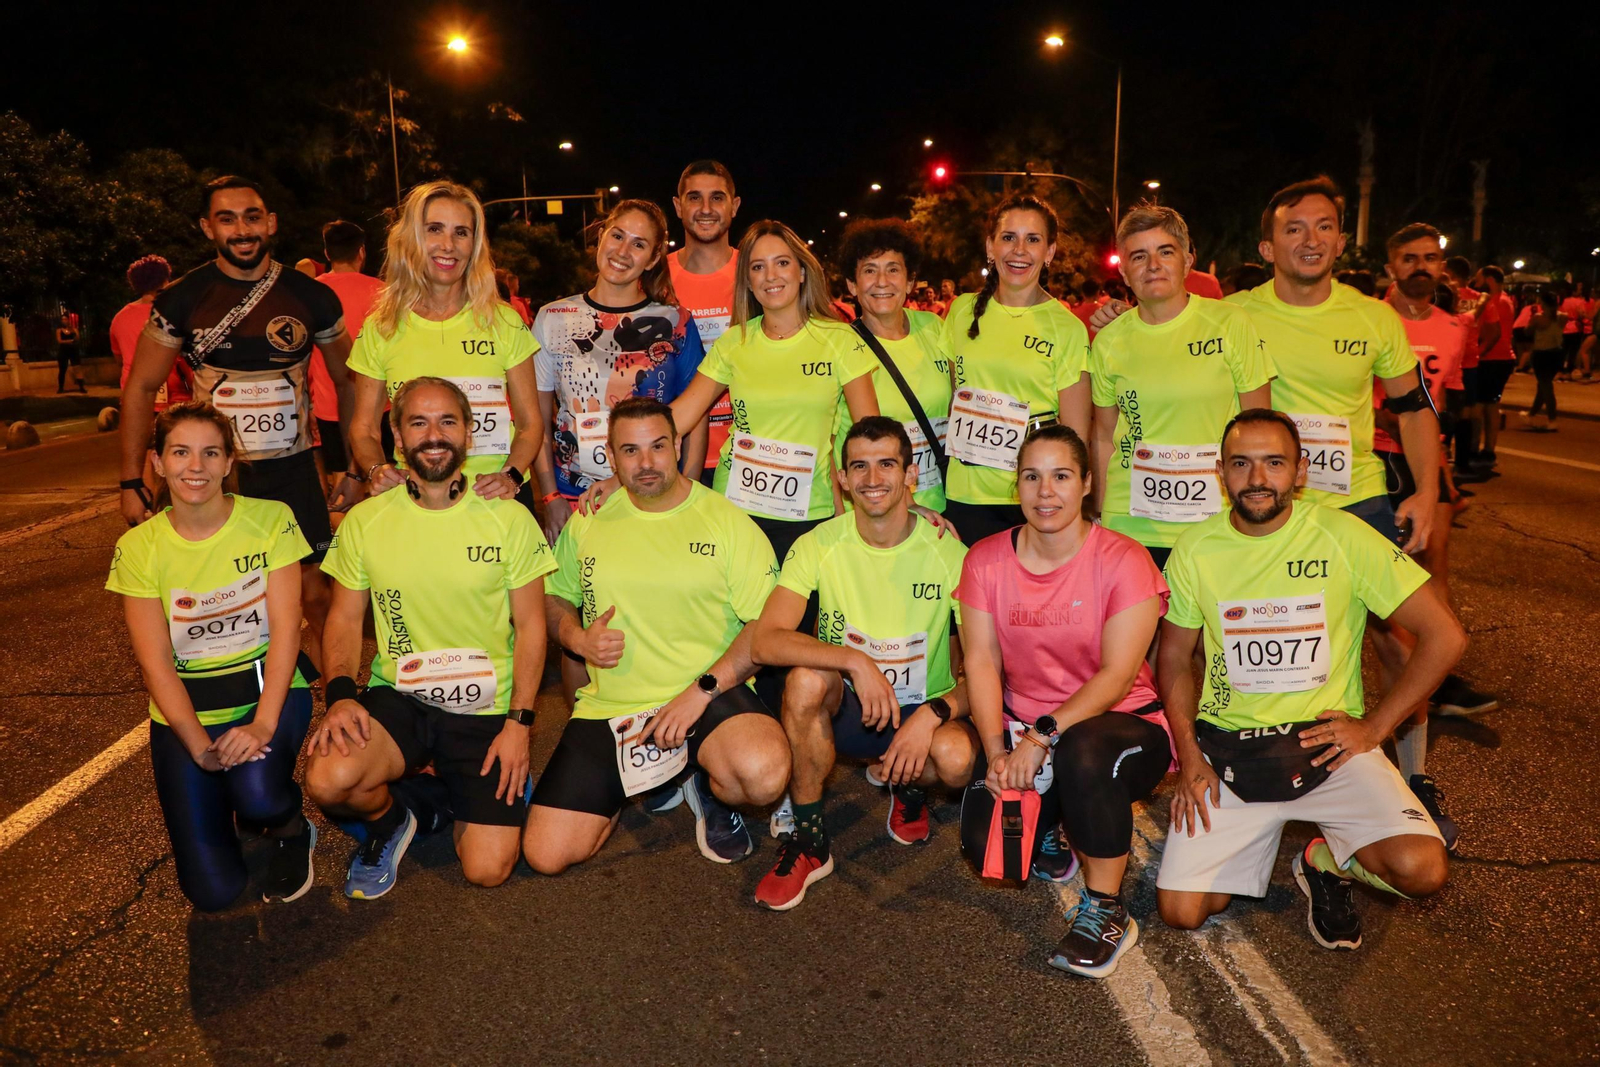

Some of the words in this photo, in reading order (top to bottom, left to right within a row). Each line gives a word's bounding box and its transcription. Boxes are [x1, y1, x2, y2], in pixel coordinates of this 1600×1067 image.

[461, 340, 495, 356] UCI
[1024, 335, 1054, 357] UCI
[1188, 338, 1224, 356] UCI
[1333, 340, 1368, 356] UCI
[801, 362, 832, 376] UCI
[230, 412, 286, 433] 1268
[955, 417, 1018, 450] 11452
[742, 467, 798, 497] 9670
[1143, 477, 1207, 501] 9802
[466, 546, 502, 563] UCI
[689, 542, 716, 557] UCI
[233, 551, 269, 574] UCI
[1286, 559, 1328, 579] UCI
[912, 583, 941, 600] UCI
[187, 609, 263, 640] 9074
[1009, 610, 1082, 626] RUNNING
[1232, 636, 1322, 666] 10977
[413, 683, 481, 704] 5849
